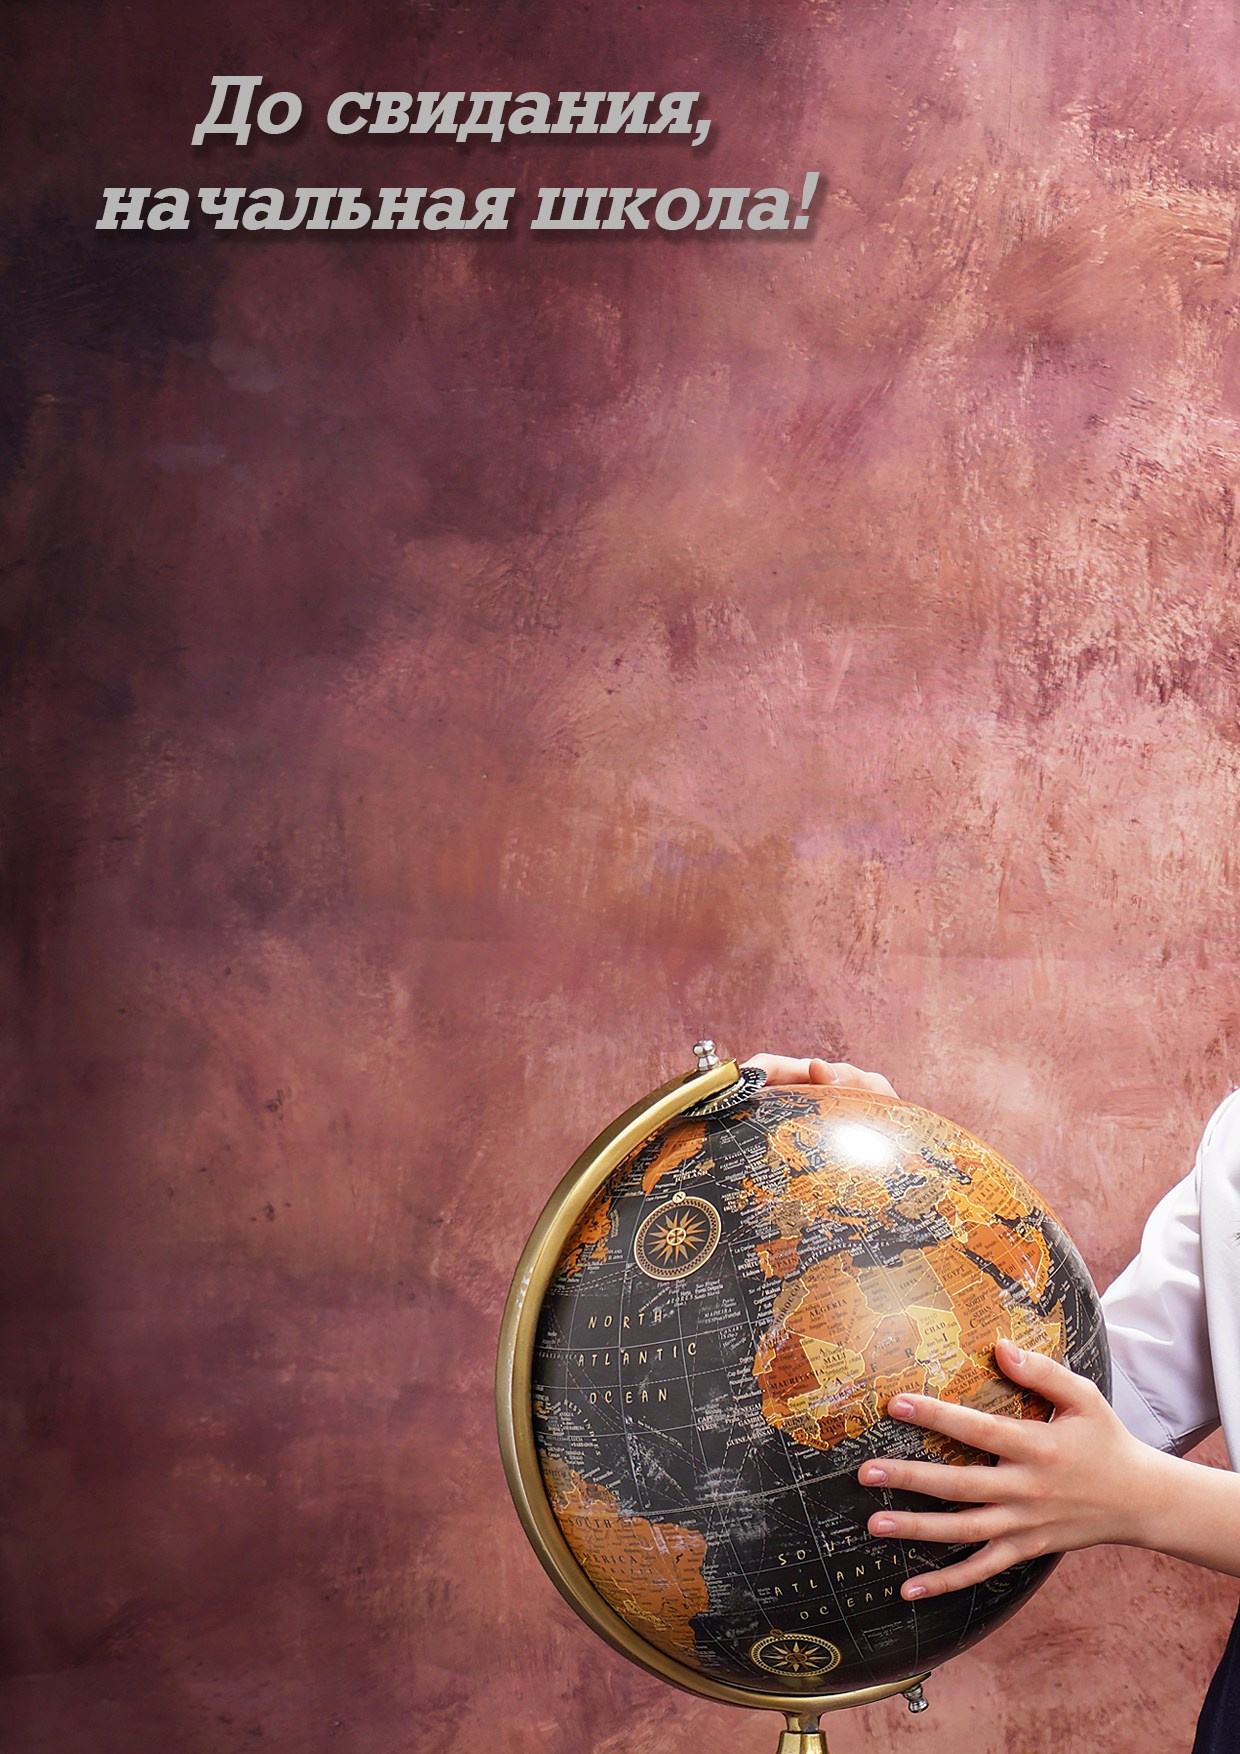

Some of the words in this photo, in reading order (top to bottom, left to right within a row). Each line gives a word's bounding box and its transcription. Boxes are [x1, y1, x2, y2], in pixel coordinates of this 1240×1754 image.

[588, 1310, 664, 1329] NORTH
[924, 1322, 947, 1336] CHAD
[577, 1342, 698, 1367] ATLANTIC
[589, 1388, 669, 1405] OCEAN
[568, 1518, 613, 1529] SOUTH
[778, 1530, 872, 1566] SOUTH
[773, 1548, 918, 1598] ATLANTIC
[800, 1586, 894, 1621] OCEAN
